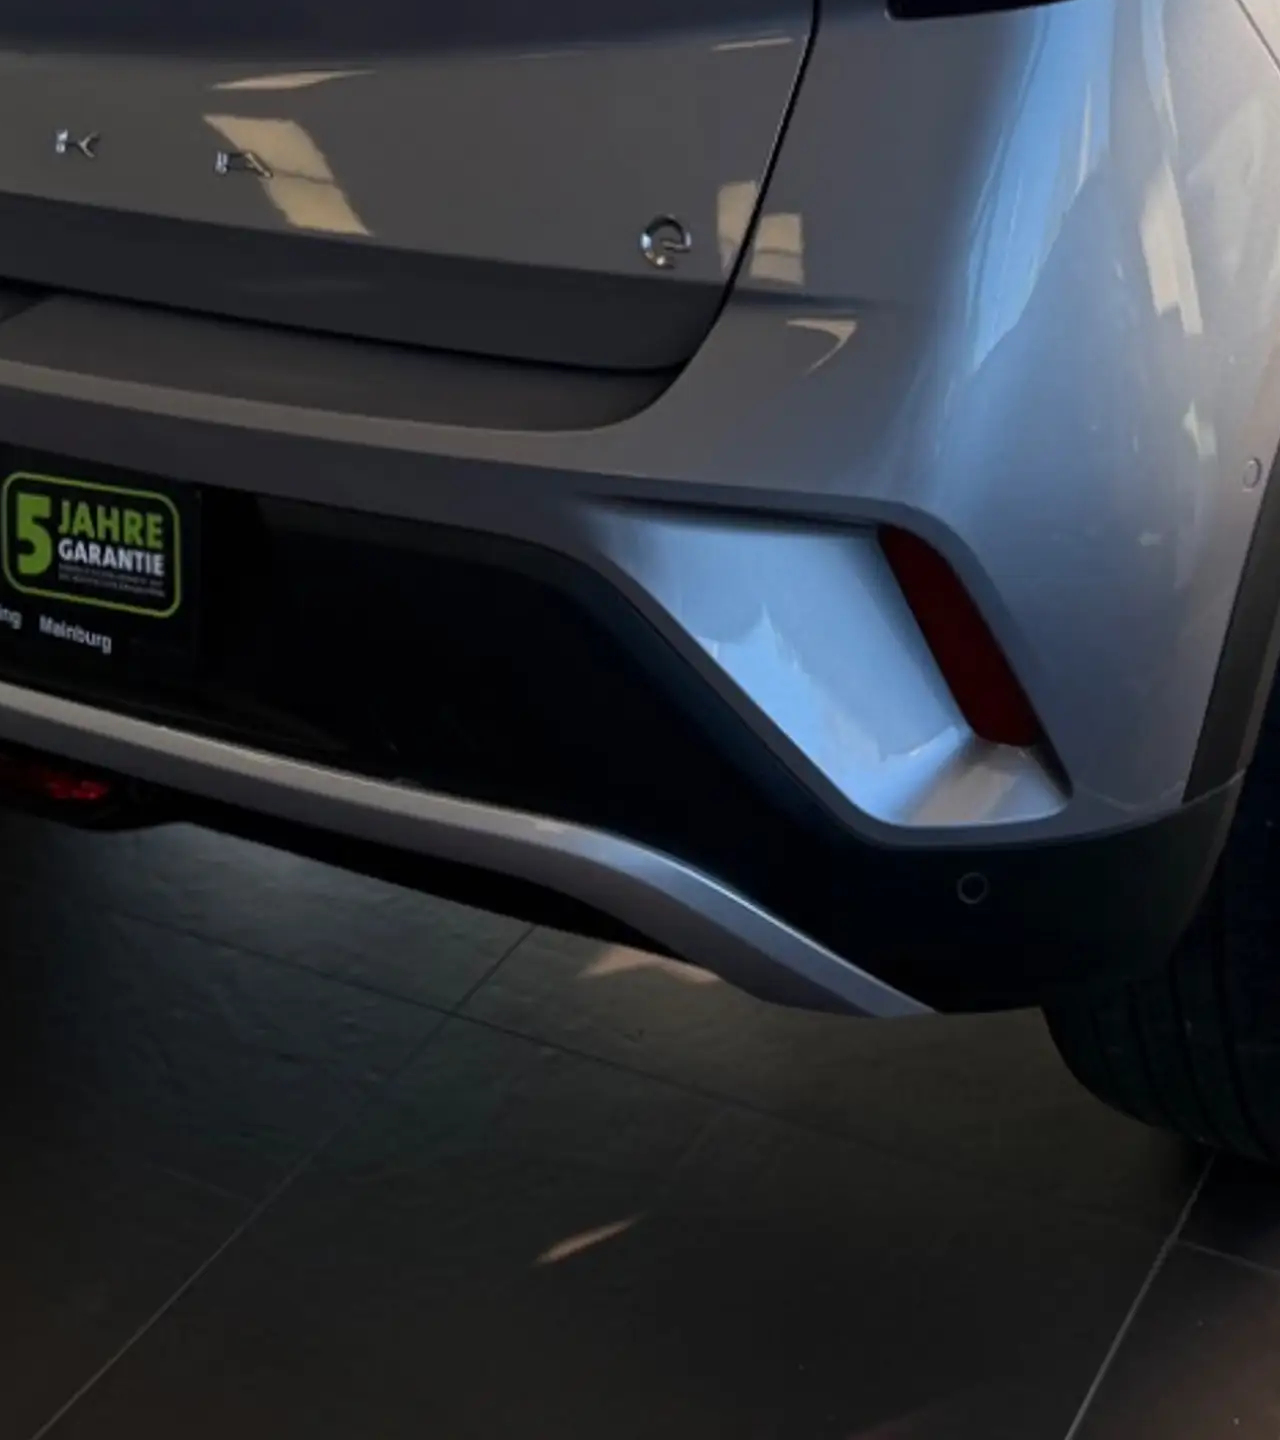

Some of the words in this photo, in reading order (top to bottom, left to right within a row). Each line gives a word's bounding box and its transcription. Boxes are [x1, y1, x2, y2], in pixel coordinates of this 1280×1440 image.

[16, 491, 53, 575] 5
[57, 499, 164, 550] JAHRE
[57, 537, 165, 578] GARANTIE
[38, 613, 112, 655] Mainburg
